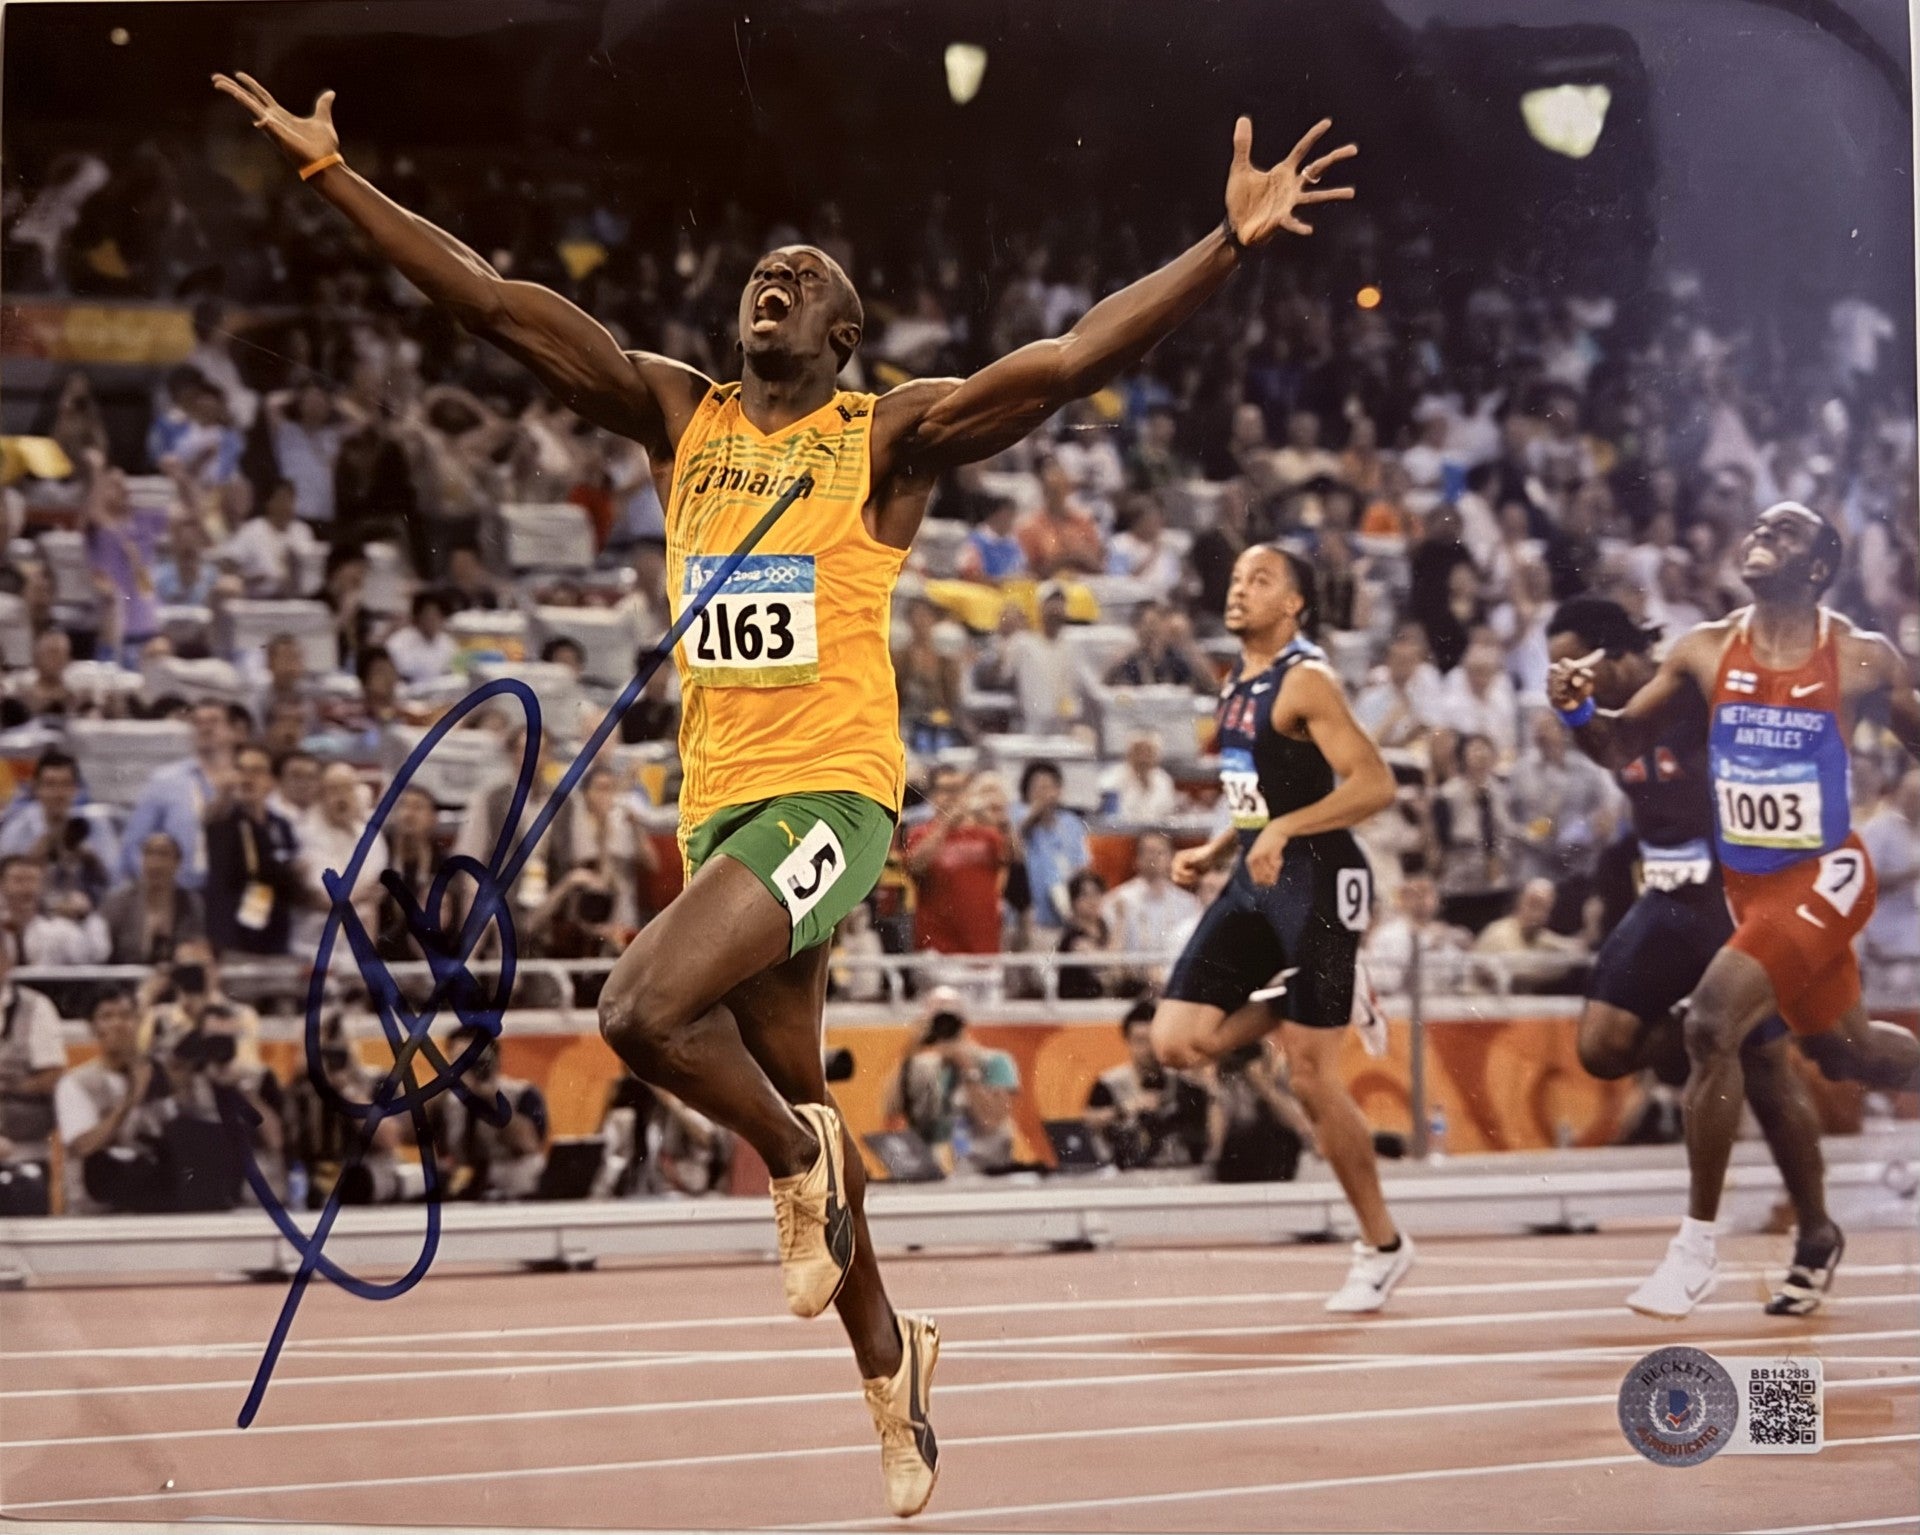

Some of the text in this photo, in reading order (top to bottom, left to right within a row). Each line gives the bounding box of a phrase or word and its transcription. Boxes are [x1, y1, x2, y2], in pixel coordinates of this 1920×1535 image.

[695, 602, 794, 660] 2163
[1720, 705, 1826, 732] NETHERLANDS
[1734, 727, 1802, 749] ANTILLES
[1725, 788, 1803, 831] 1003
[787, 842, 837, 900] 5
[1831, 857, 1857, 894] 7
[1346, 878, 1361, 920] 9
[1641, 1359, 1714, 1386] BECKETT
[1751, 1369, 1809, 1379] BB14288
